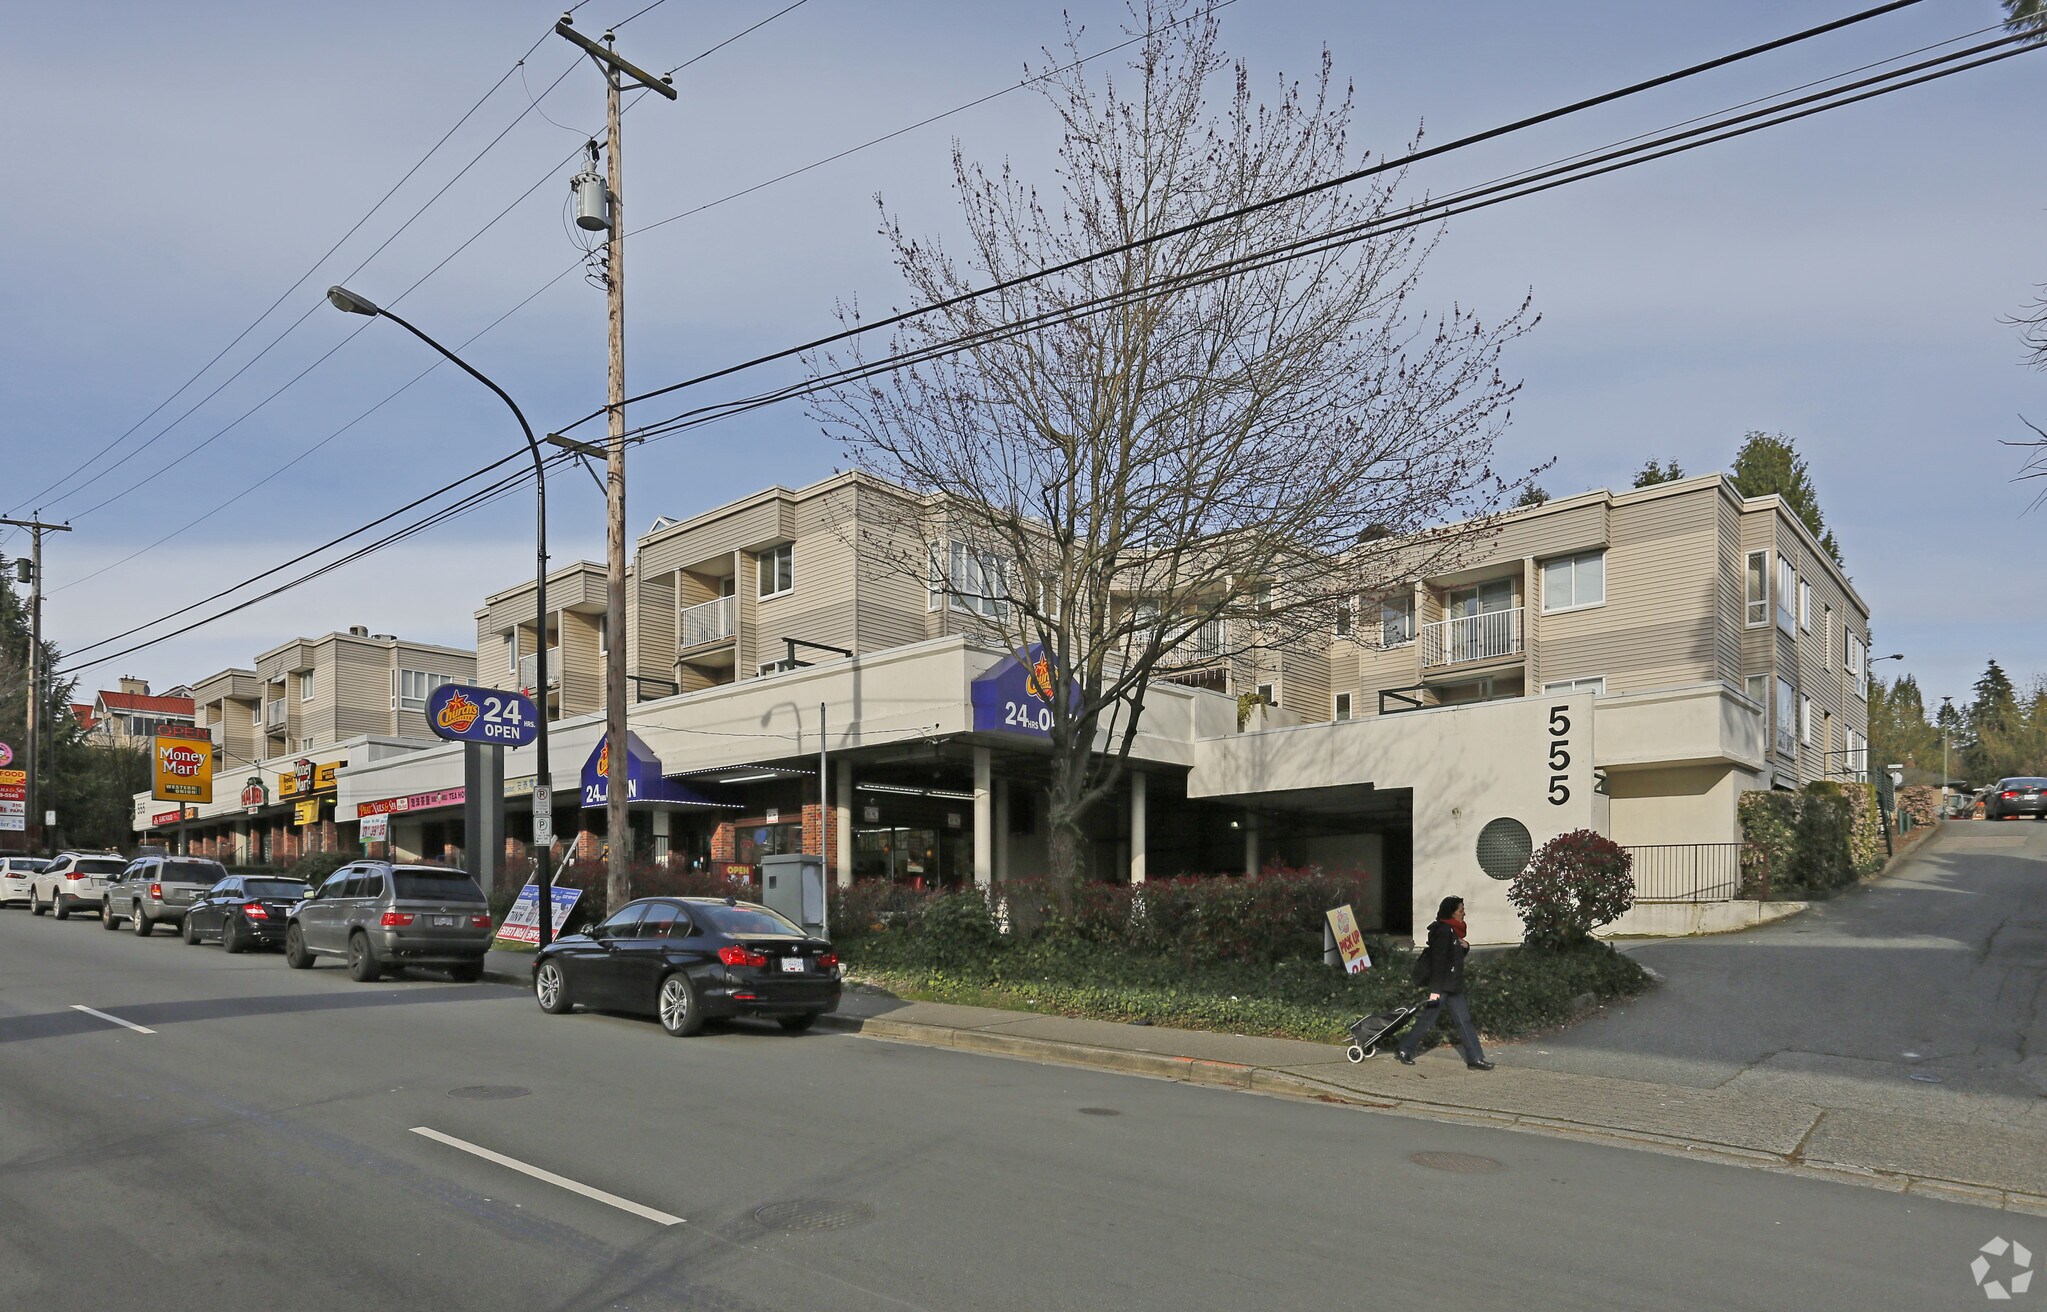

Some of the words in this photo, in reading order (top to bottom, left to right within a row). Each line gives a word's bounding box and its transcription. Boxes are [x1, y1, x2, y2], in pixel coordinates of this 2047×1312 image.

[483, 697, 522, 724] 24
[1005, 701, 1028, 727] 24
[158, 724, 208, 739] OPEN
[484, 723, 520, 739] OPEN
[160, 746, 207, 766] Money
[1548, 705, 1570, 805] 555
[163, 761, 199, 775] Mart
[449, 792, 458, 800] TEA
[586, 784, 599, 803] 24
[727, 866, 750, 875] OPEN
[1339, 935, 1354, 954] PICK
[1352, 930, 1360, 944] UP
